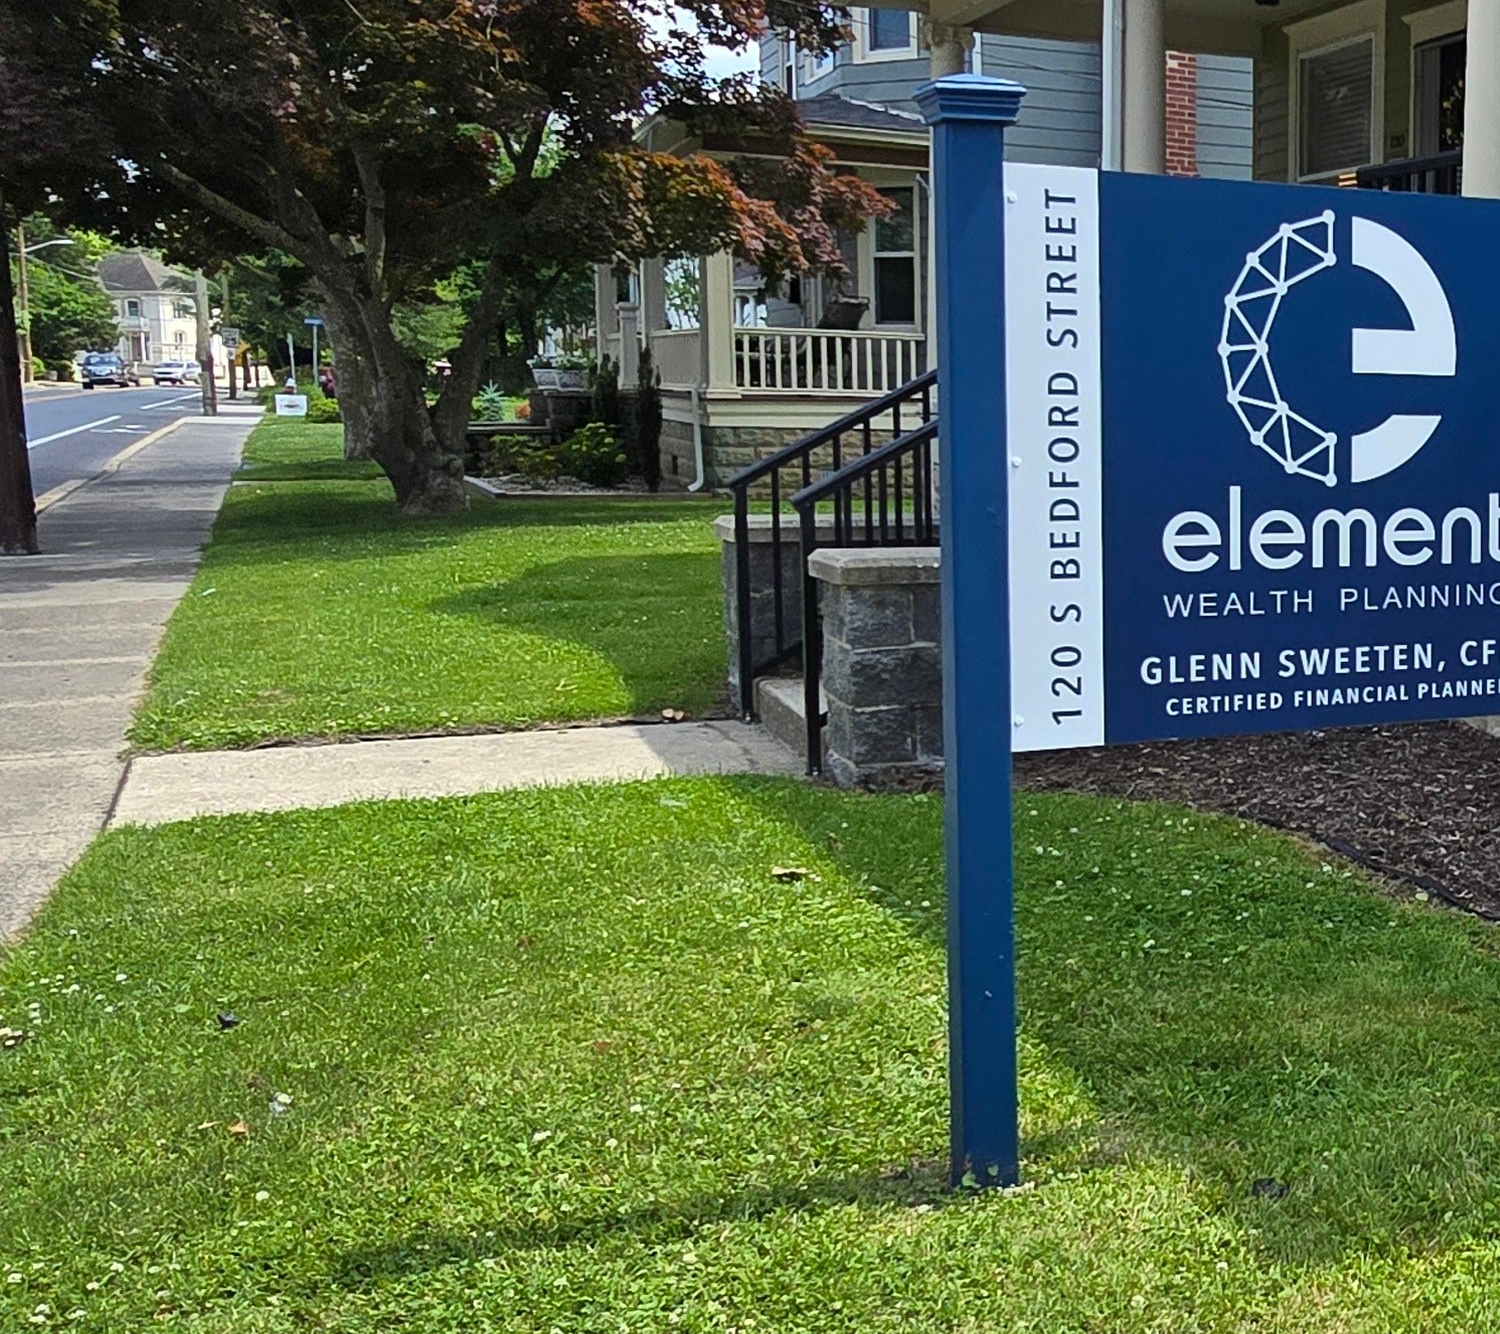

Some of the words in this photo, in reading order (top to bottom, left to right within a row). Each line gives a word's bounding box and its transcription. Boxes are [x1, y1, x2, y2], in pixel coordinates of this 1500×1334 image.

[1043, 187, 1080, 350] STREET
[1046, 371, 1082, 581] BEDFORD
[1048, 602, 1083, 624] S
[1162, 589, 1313, 619] WEALTH
[1050, 644, 1084, 727] 120
[1139, 652, 1261, 686] GLENN
[1277, 642, 1447, 679] SWEETEN,
[1165, 691, 1284, 716] CERTIFIED
[1293, 684, 1410, 708] FINANCIAL
